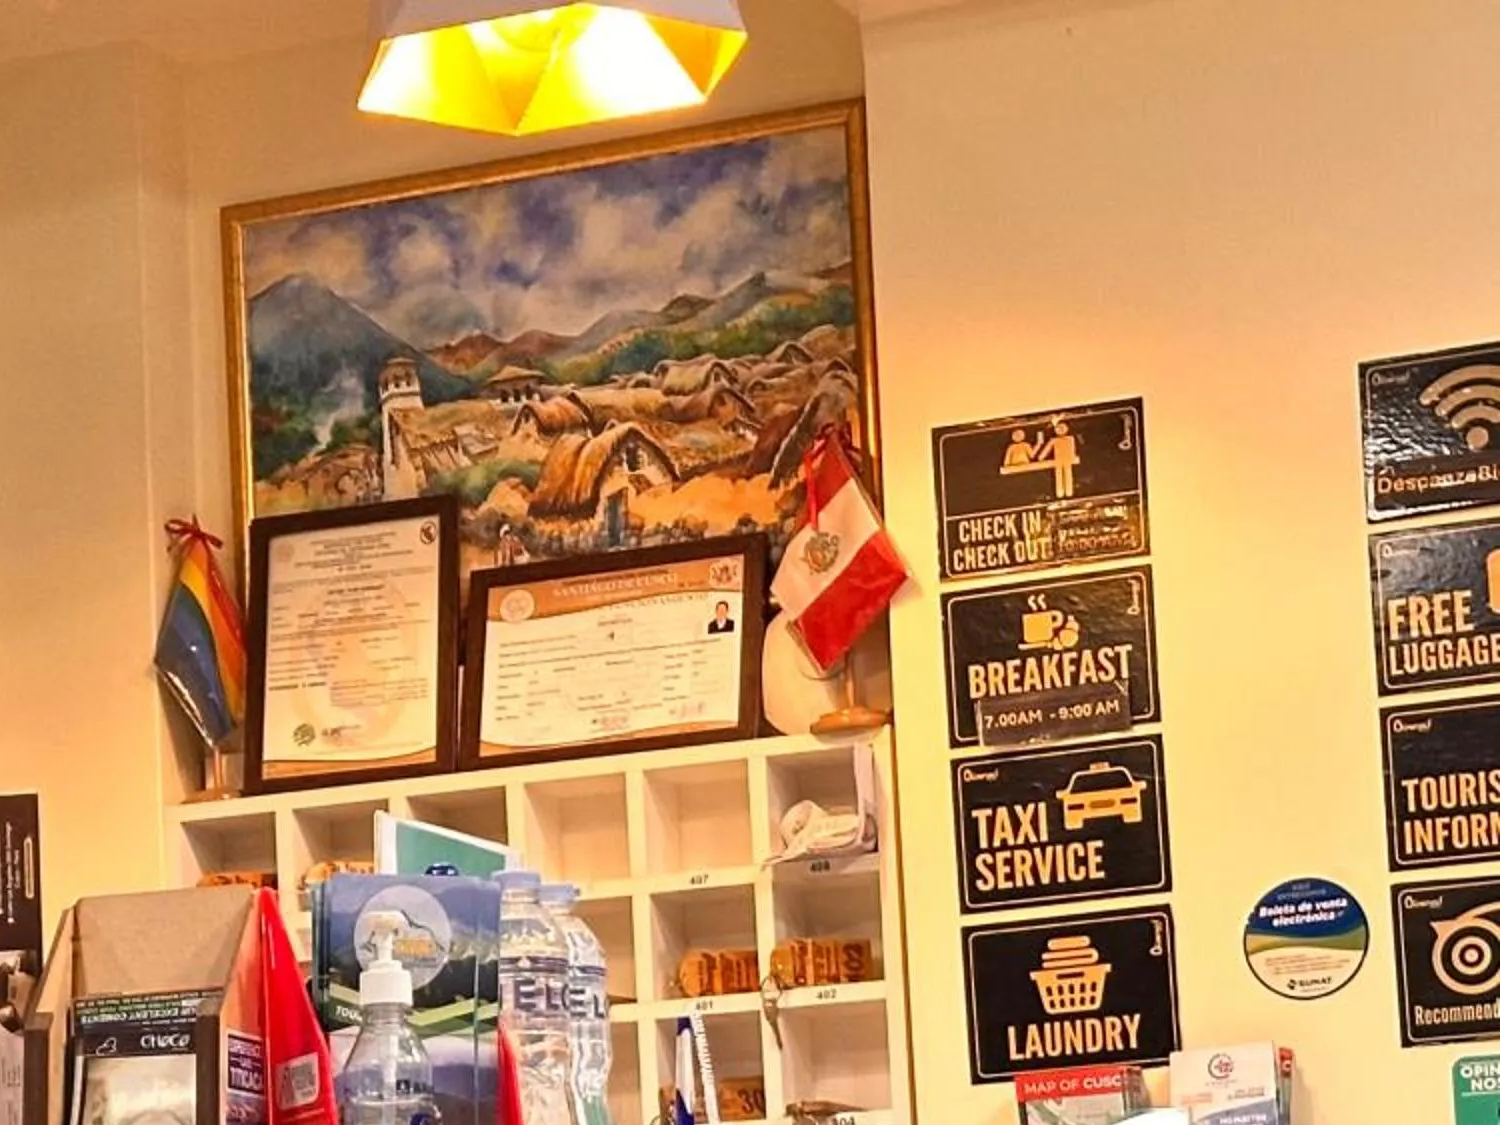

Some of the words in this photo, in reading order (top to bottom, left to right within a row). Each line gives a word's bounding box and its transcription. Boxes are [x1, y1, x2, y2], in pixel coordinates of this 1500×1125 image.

[959, 513, 1017, 543] CHECK
[1022, 510, 1043, 536] IN
[953, 541, 1011, 571] CHECK
[1014, 537, 1052, 563] OUT
[1387, 590, 1475, 641] FREE
[968, 644, 1133, 699] BREAKFAST
[1388, 633, 1500, 676] LUGGAGE
[971, 801, 1049, 849] TAXI
[975, 840, 1106, 891] SERVICE
[1008, 1013, 1141, 1061] LAUNDRY
[1024, 1081, 1057, 1094] MAP
[1060, 1078, 1080, 1091] OF
[1083, 1073, 1124, 1089] CUSC
